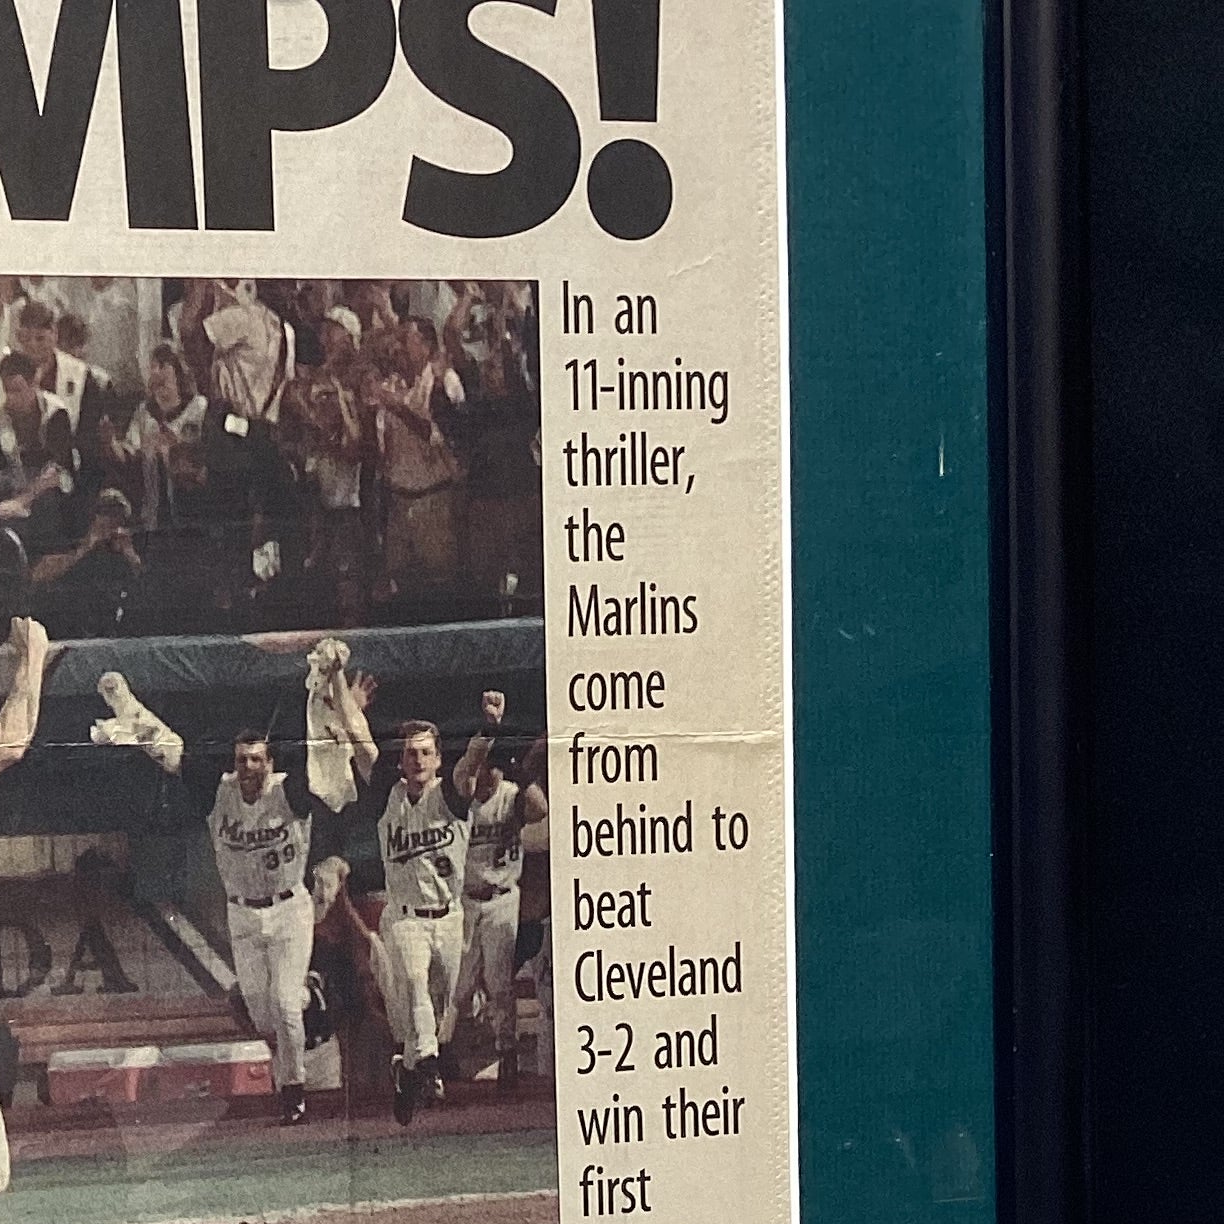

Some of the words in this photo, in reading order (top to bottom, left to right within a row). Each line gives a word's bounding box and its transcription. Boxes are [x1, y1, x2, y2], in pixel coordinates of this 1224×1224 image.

[562, 280, 594, 334] In
[614, 295, 657, 334] an
[565, 357, 728, 424] 11-inning
[563, 431, 695, 494] thriller,
[564, 507, 625, 562] the
[568, 581, 698, 637] Marlins
[569, 670, 665, 712] come
[568, 732, 659, 785] from
[572, 800, 693, 858] behind
[711, 806, 748, 851] to
[574, 880, 652, 931] beat
[575, 941, 742, 1002] Cleveland
[577, 1022, 635, 1075] 3-2
[654, 1014, 718, 1069] and
[577, 1093, 643, 1146] win
[662, 1086, 745, 1139] their
[579, 1164, 651, 1217] first
